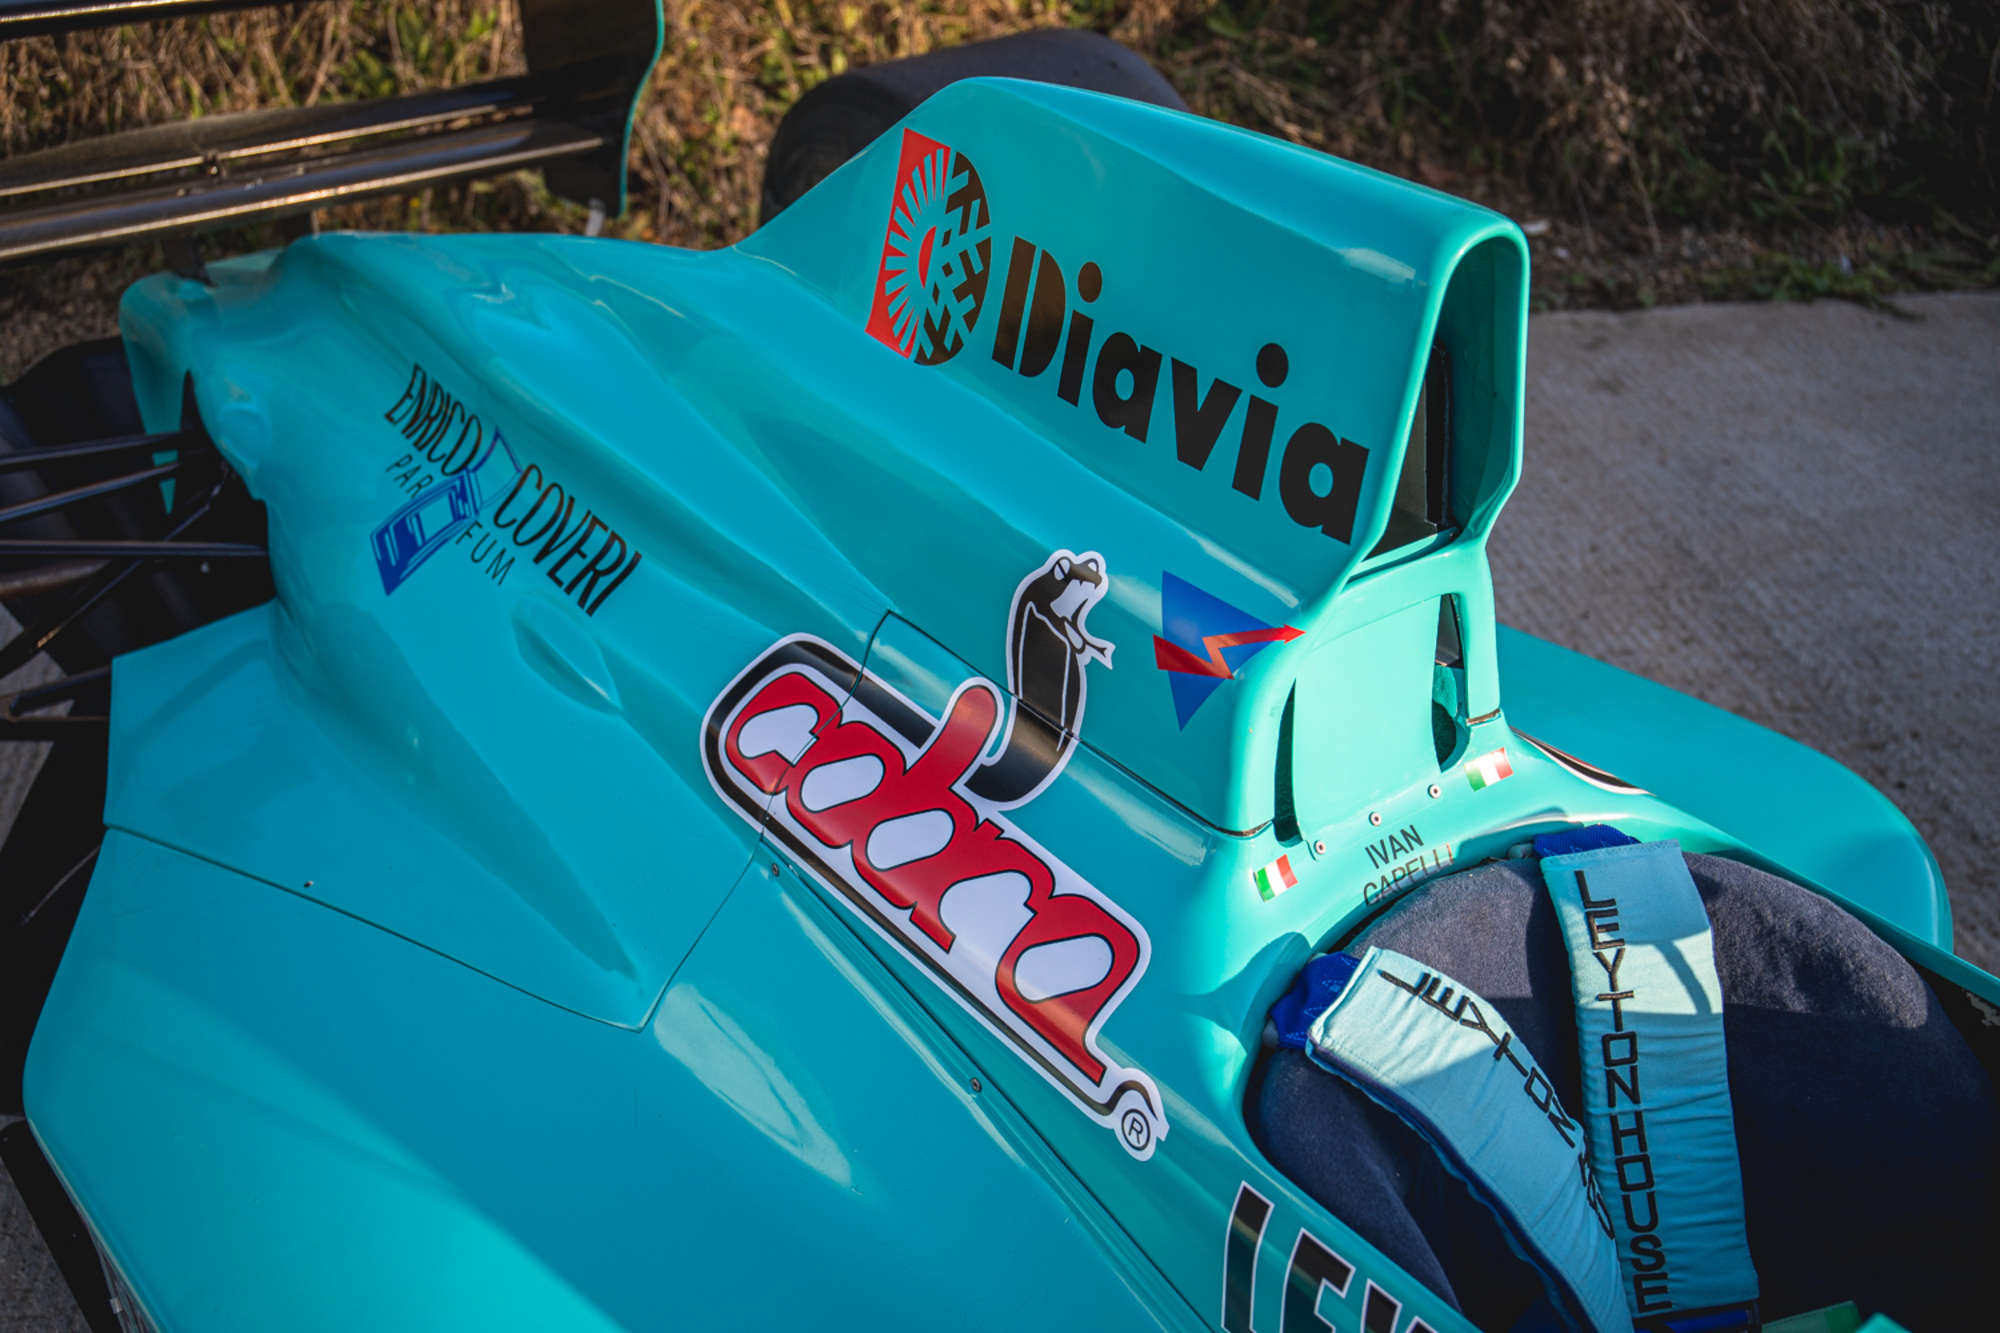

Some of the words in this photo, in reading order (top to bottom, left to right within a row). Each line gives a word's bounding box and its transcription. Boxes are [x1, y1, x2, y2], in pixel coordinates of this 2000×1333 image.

[992, 235, 1370, 545] Diavia
[384, 362, 483, 476] ENRICO
[493, 463, 642, 617] COVERI
[385, 453, 434, 499] PAR
[455, 520, 516, 586] FUM
[725, 671, 1141, 1088] cobra
[1362, 843, 1455, 907] CAPELLI
[1364, 824, 1425, 869] IVAN
[1376, 969, 1577, 1149] LEYTON
